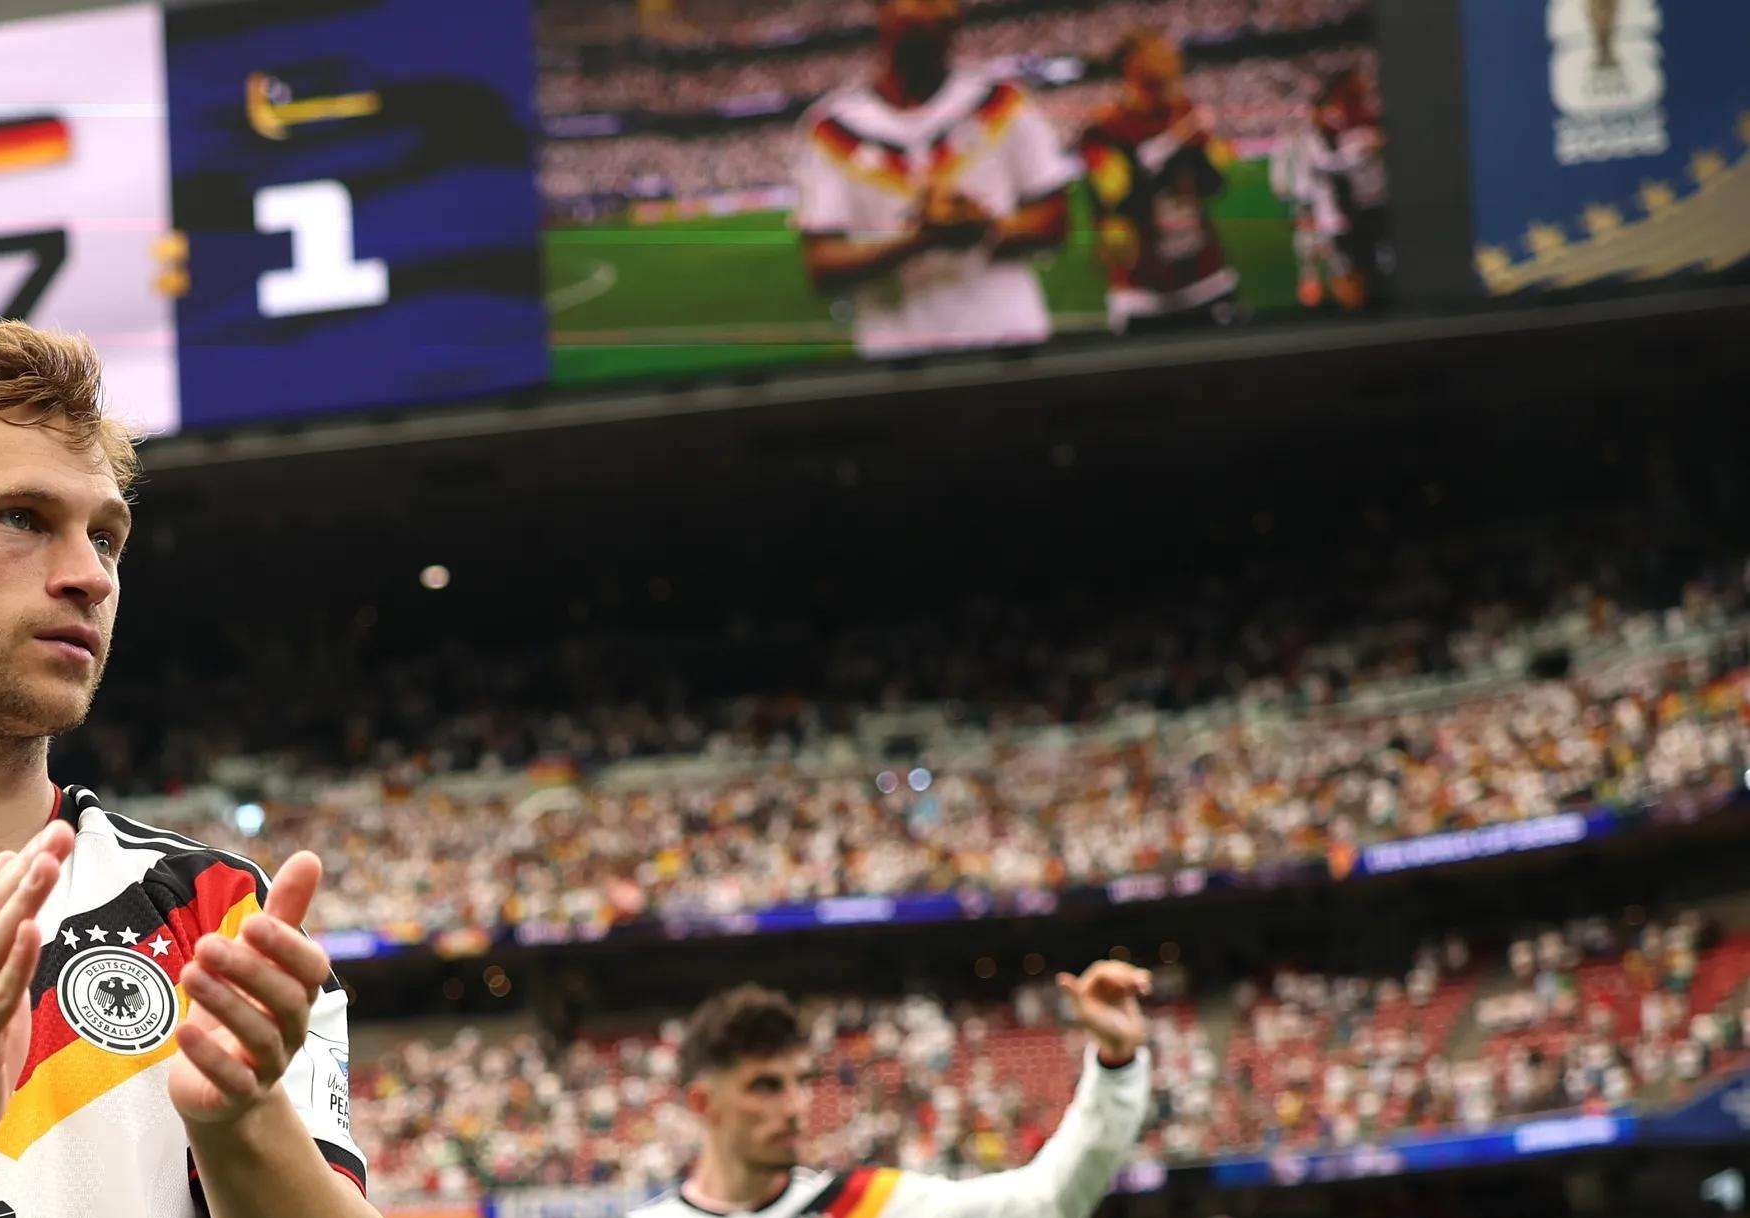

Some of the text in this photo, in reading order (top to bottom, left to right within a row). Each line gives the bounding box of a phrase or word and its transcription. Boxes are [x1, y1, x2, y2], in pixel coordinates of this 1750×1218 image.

[253, 179, 388, 318] 1
[85, 961, 149, 982] DEUTSCHER
[81, 1004, 158, 1037] FUSSBALL-BUND
